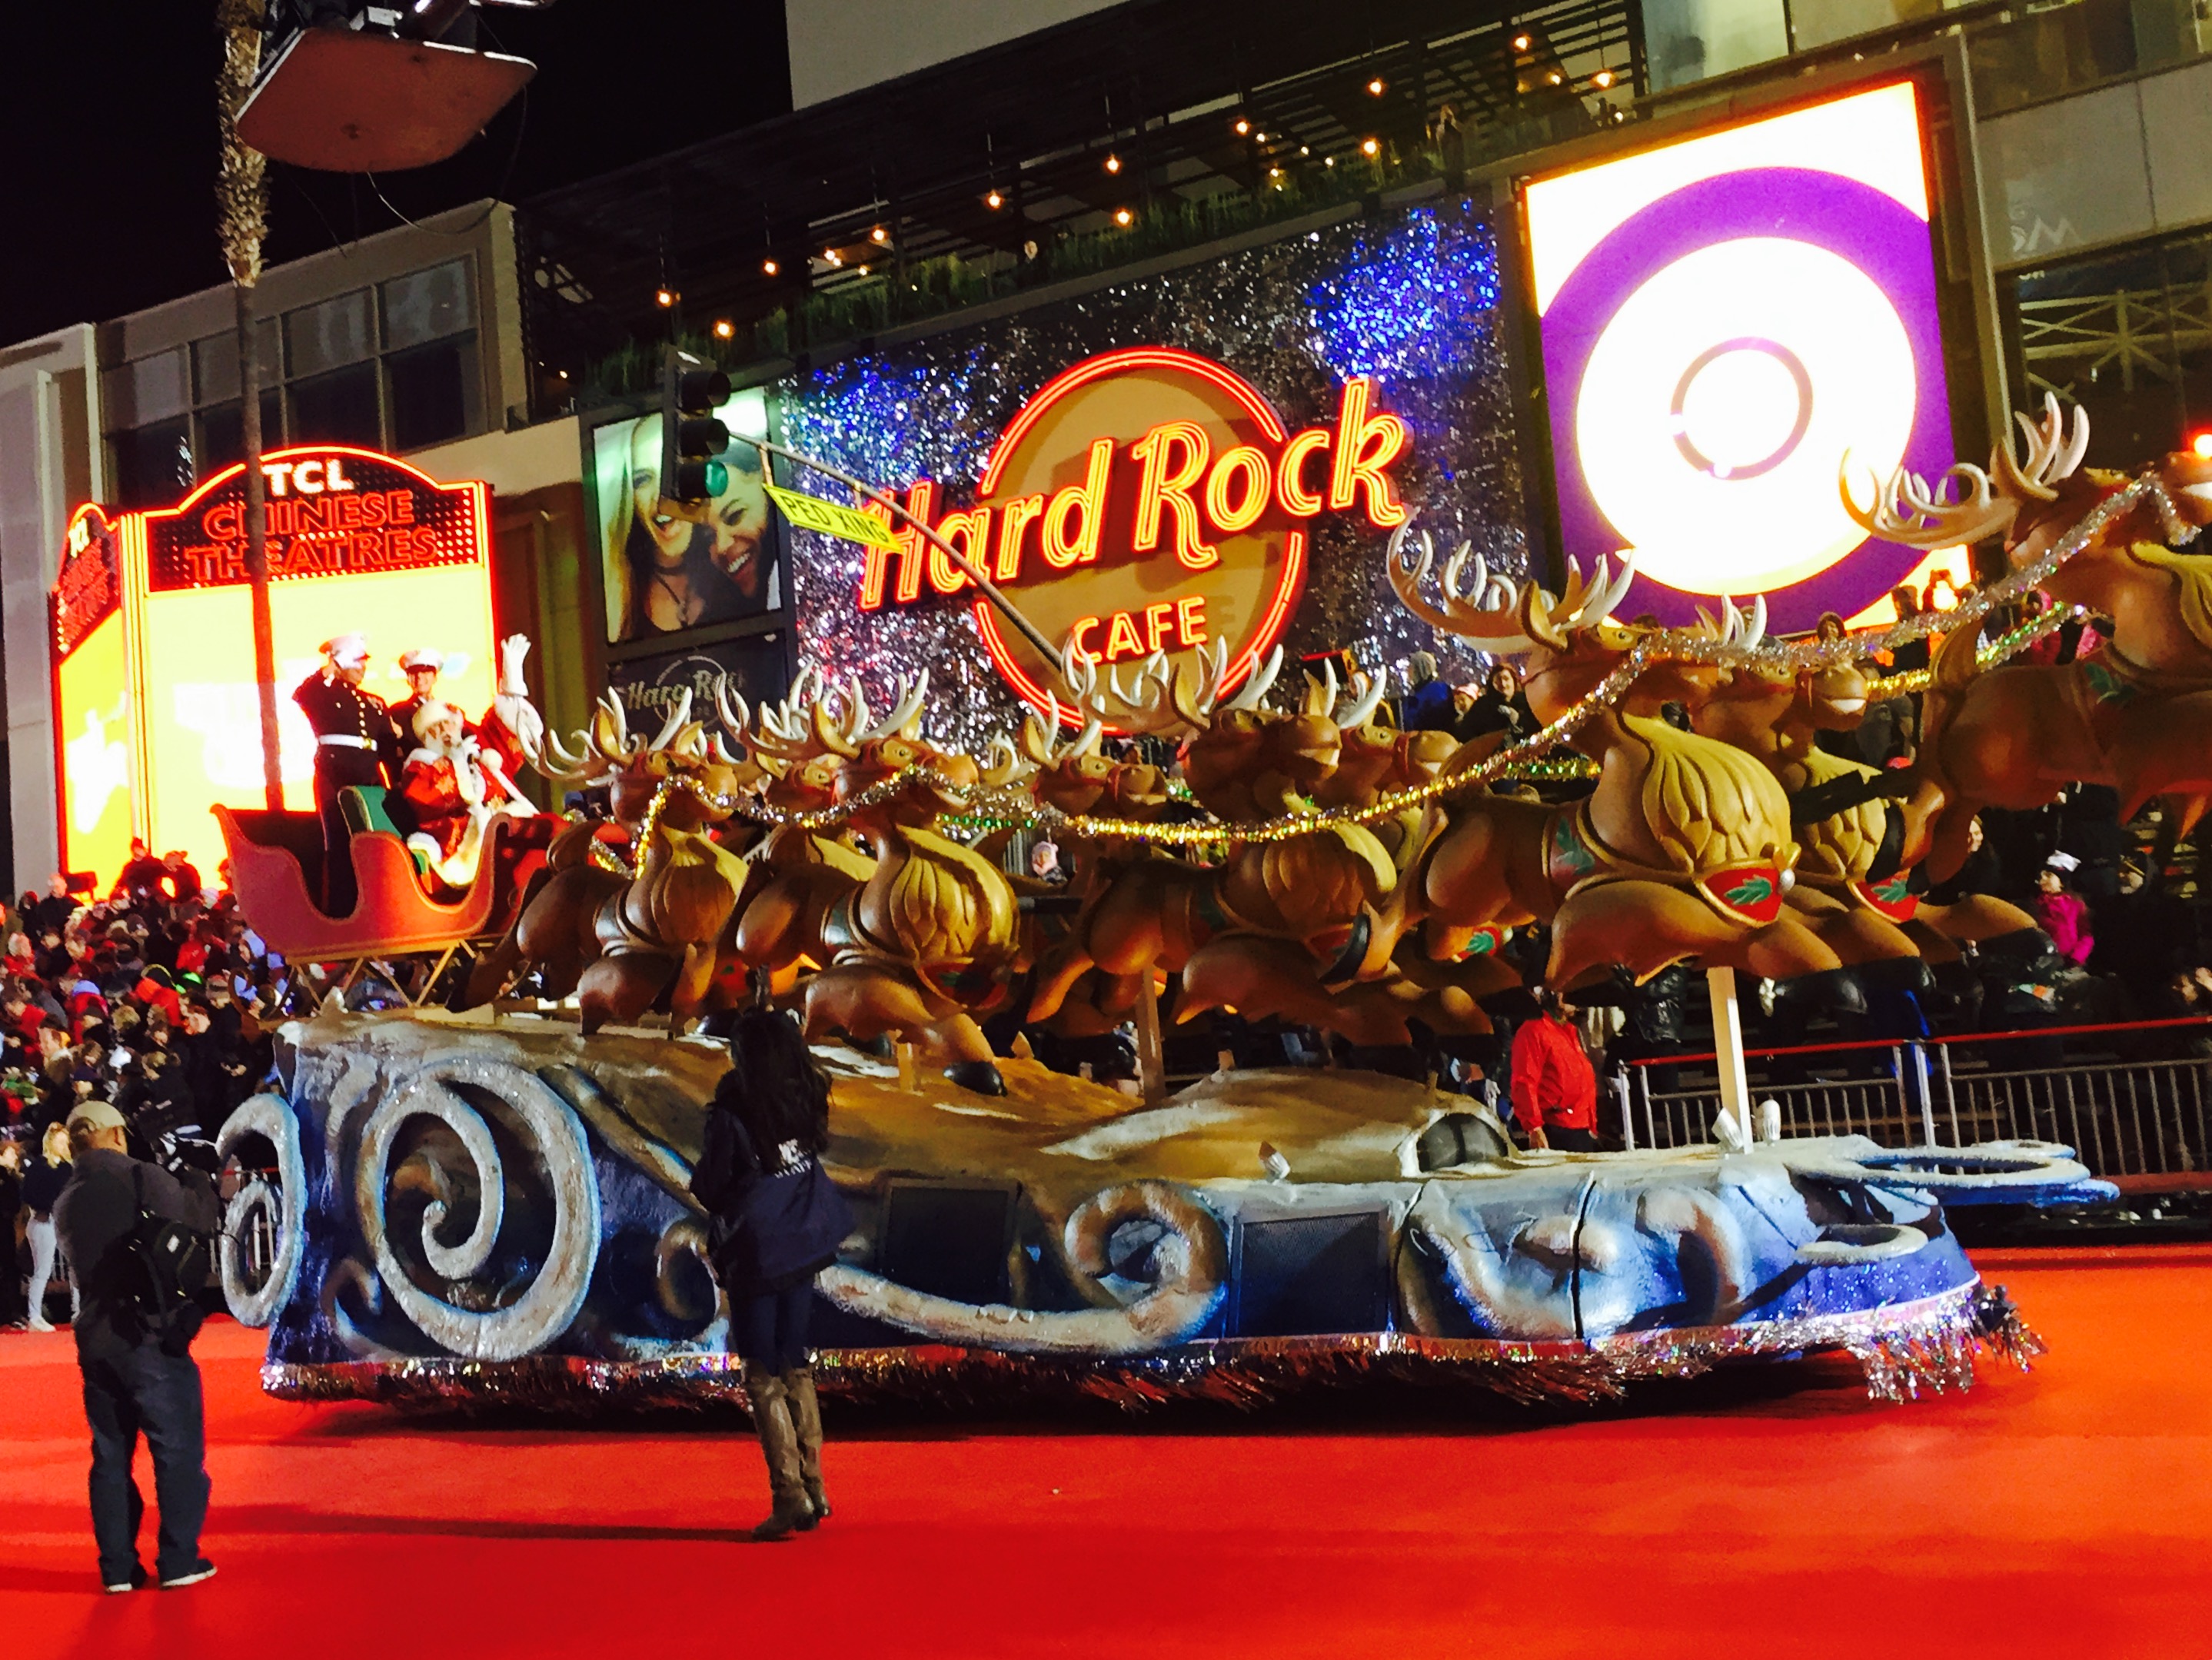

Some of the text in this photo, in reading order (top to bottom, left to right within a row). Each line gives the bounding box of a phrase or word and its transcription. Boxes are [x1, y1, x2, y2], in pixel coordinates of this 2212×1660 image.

[261, 459, 354, 496] TCL
[860, 377, 1408, 610] Hard Rock
[779, 494, 890, 543] PED XING
[1072, 595, 1208, 664] CAFE
